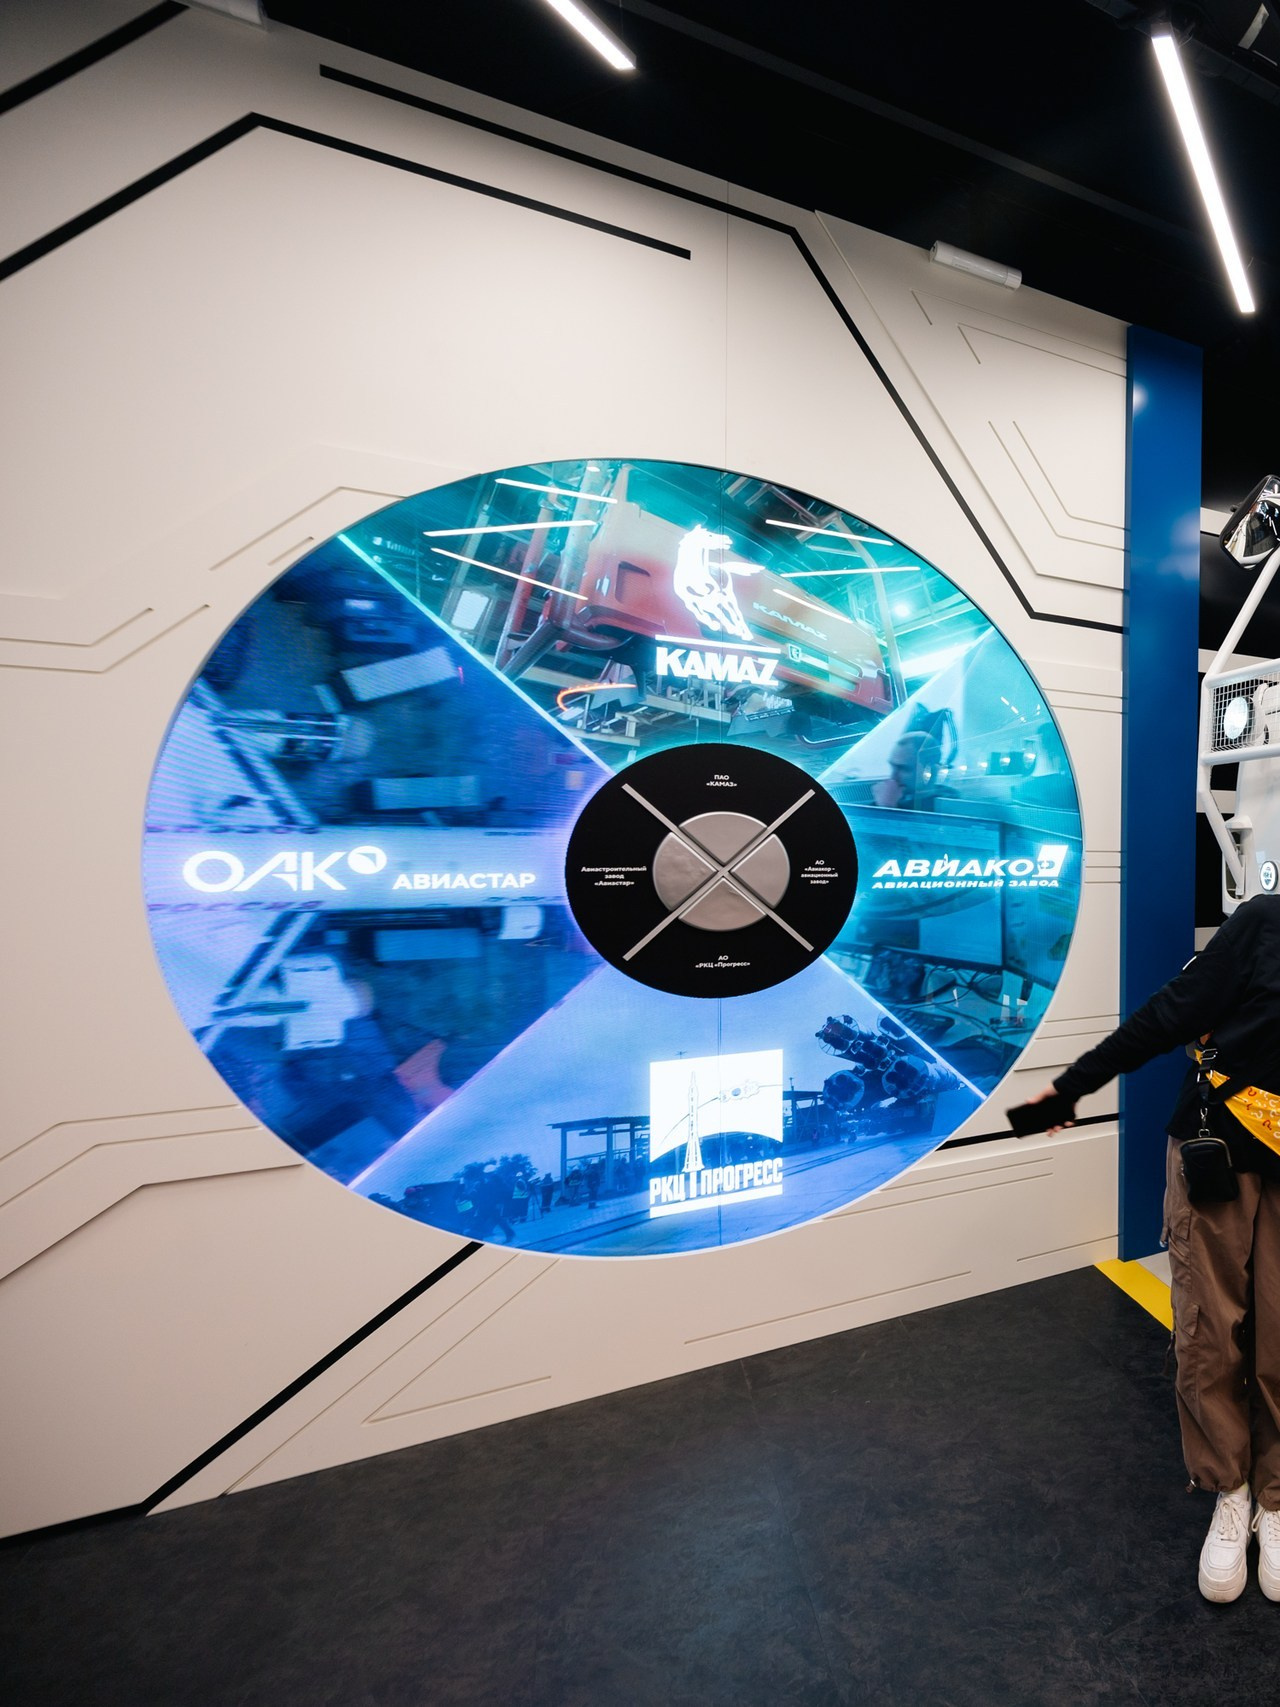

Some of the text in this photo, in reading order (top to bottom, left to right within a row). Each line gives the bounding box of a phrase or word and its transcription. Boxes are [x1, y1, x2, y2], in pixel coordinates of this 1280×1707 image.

[656, 647, 779, 686] KAMAZ
[182, 850, 347, 893] ОАК
[581, 866, 647, 874] Авиастроительный
[800, 871, 838, 879] авиационный
[392, 873, 536, 890] АВИАСТАР
[594, 880, 635, 888] «Авиастар»
[872, 879, 1059, 890] АВИАЦИОННЫЙ ЗАВОД
[650, 1157, 783, 1205] РКЦ ПРОГРЕСС
